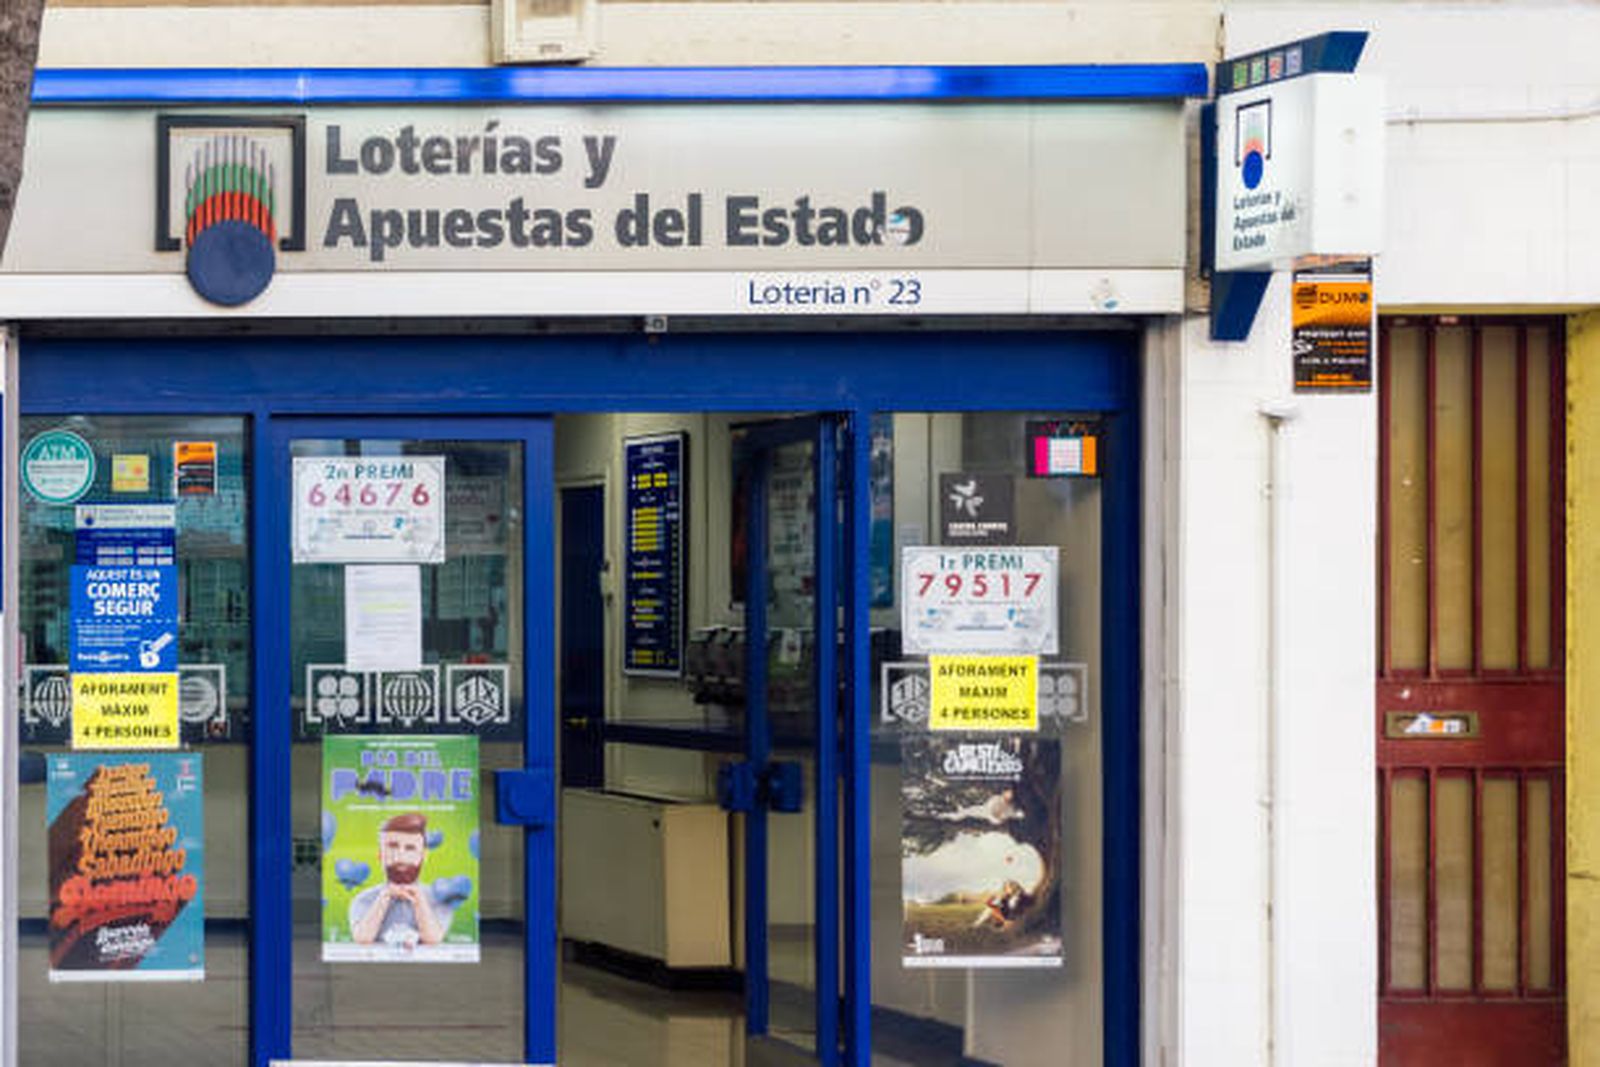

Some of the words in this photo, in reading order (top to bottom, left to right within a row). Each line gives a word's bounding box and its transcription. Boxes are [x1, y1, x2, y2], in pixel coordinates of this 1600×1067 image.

[324, 121, 562, 176] Loterías
[584, 133, 616, 188] y
[323, 197, 593, 261] Apuestas
[615, 193, 701, 247] del
[1234, 233, 1265, 250] Estado
[748, 279, 848, 306] Loteria
[888, 279, 921, 304] 23
[38, 445, 78, 460] ATM
[325, 464, 348, 480] 2n
[355, 464, 415, 479] PREMI
[308, 483, 430, 507] 64676
[963, 553, 1024, 570] PREMI
[86, 582, 161, 602] COMERÇ
[918, 573, 1043, 597] 79517
[93, 600, 154, 616] SEGUR
[938, 665, 1029, 679] AFORAMENT
[80, 682, 170, 697] AFORAMENT
[953, 708, 1030, 721] PERSONES
[82, 725, 91, 737] 4
[95, 725, 172, 738] PERSONES
[331, 769, 474, 801] PADRE
